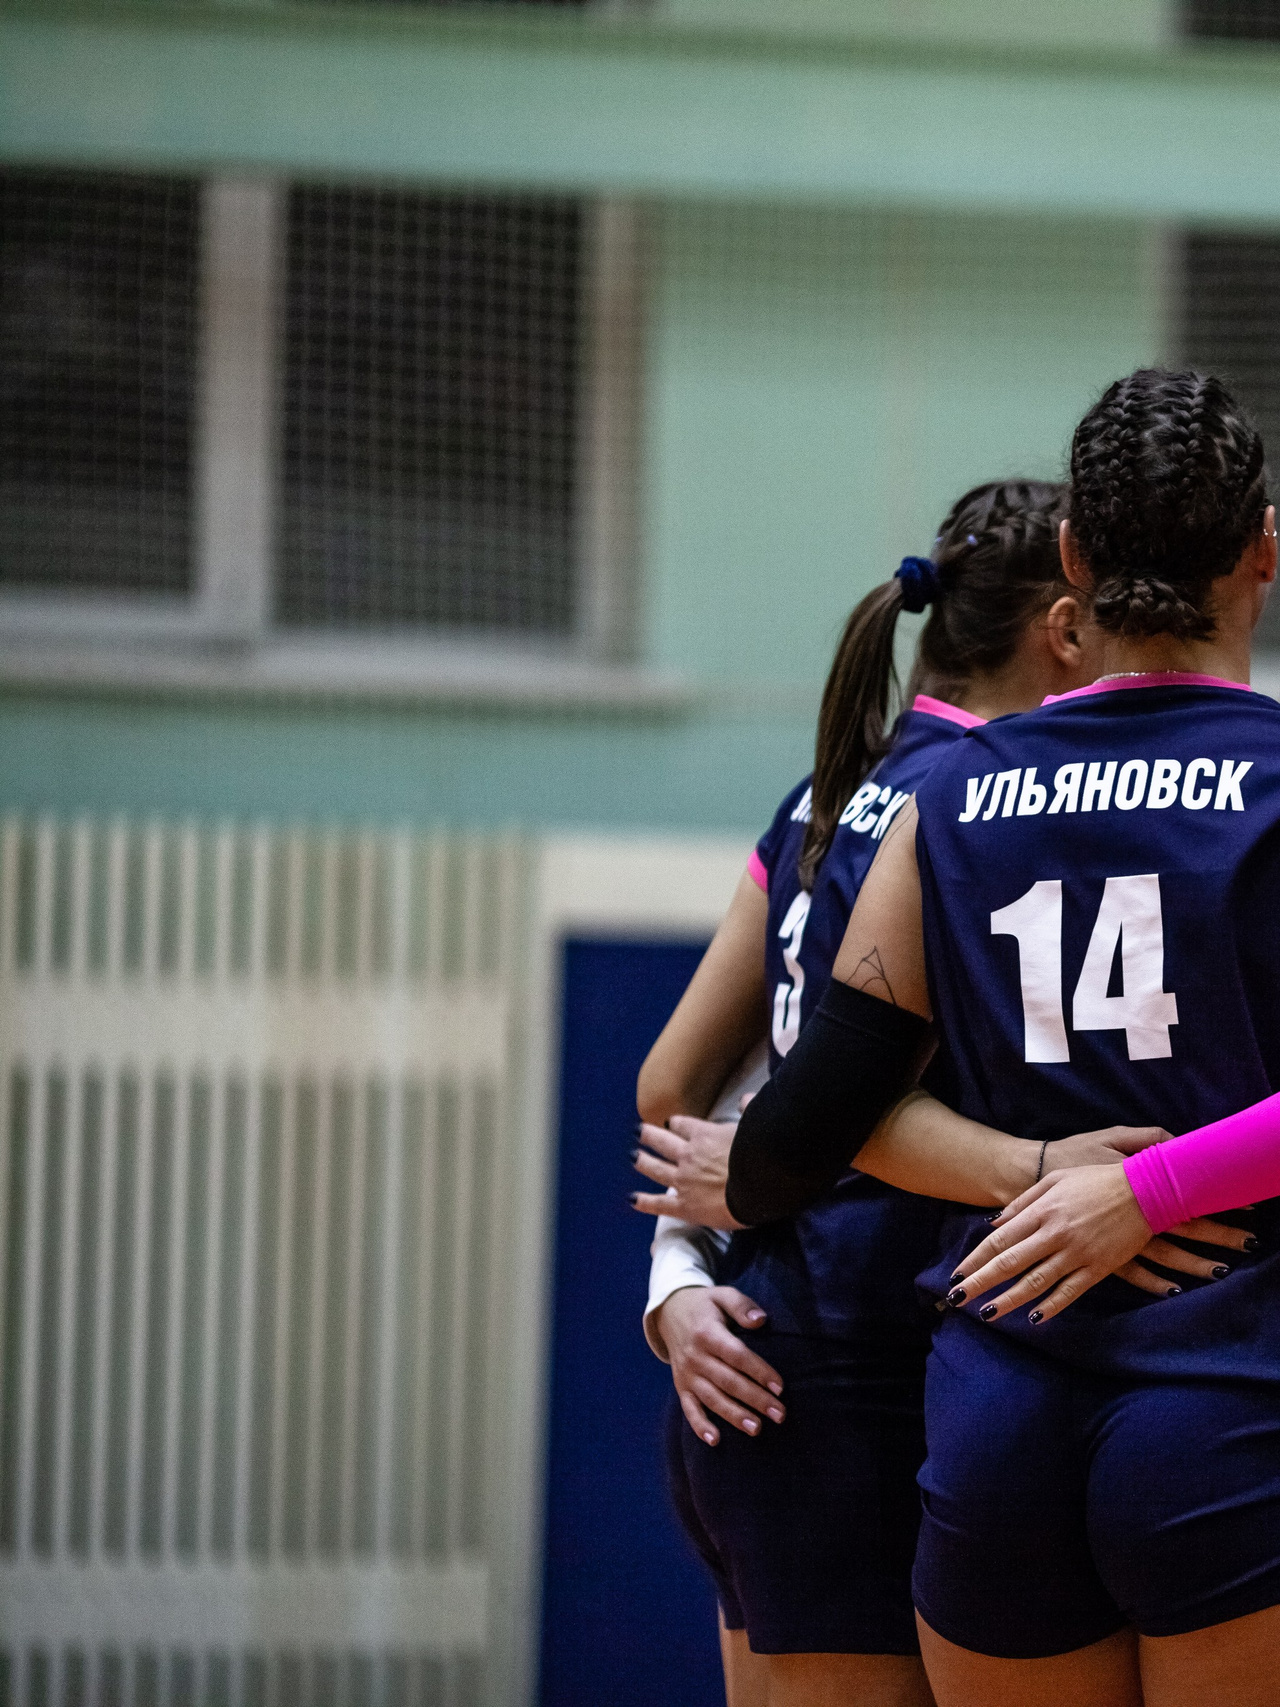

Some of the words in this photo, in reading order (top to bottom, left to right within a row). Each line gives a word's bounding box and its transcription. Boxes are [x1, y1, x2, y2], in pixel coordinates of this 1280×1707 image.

[957, 757, 1254, 823] УЛЬЯНОВСК
[771, 889, 812, 1058] 3
[990, 873, 1179, 1063] 14
